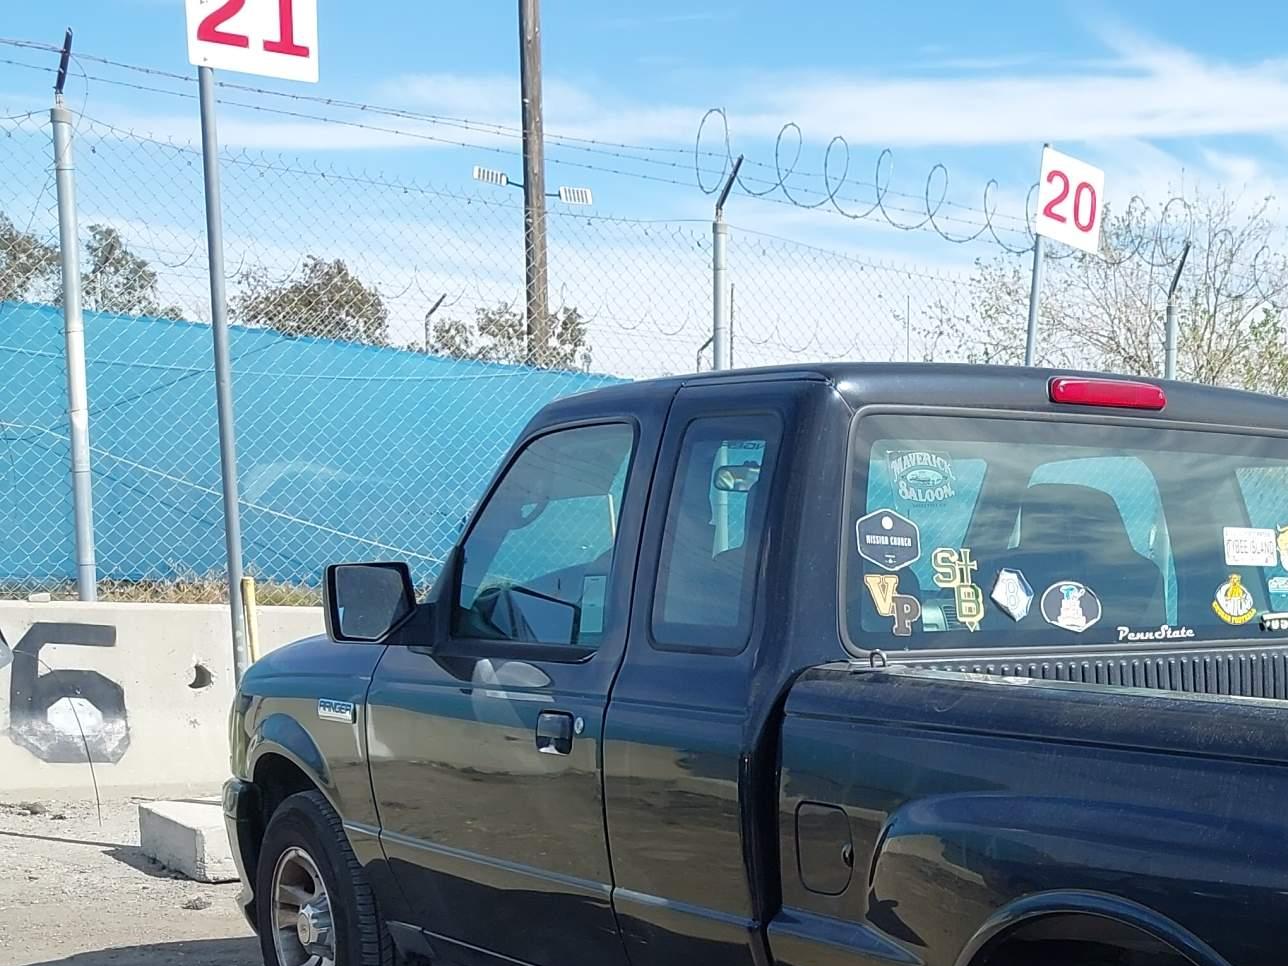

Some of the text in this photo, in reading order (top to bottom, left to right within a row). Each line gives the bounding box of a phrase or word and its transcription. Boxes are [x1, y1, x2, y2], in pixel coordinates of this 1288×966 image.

[1043, 170, 1097, 232] 20
[890, 452, 956, 482] MAVERICK
[898, 481, 952, 502] SALOON
[319, 700, 352, 714] RANGER
